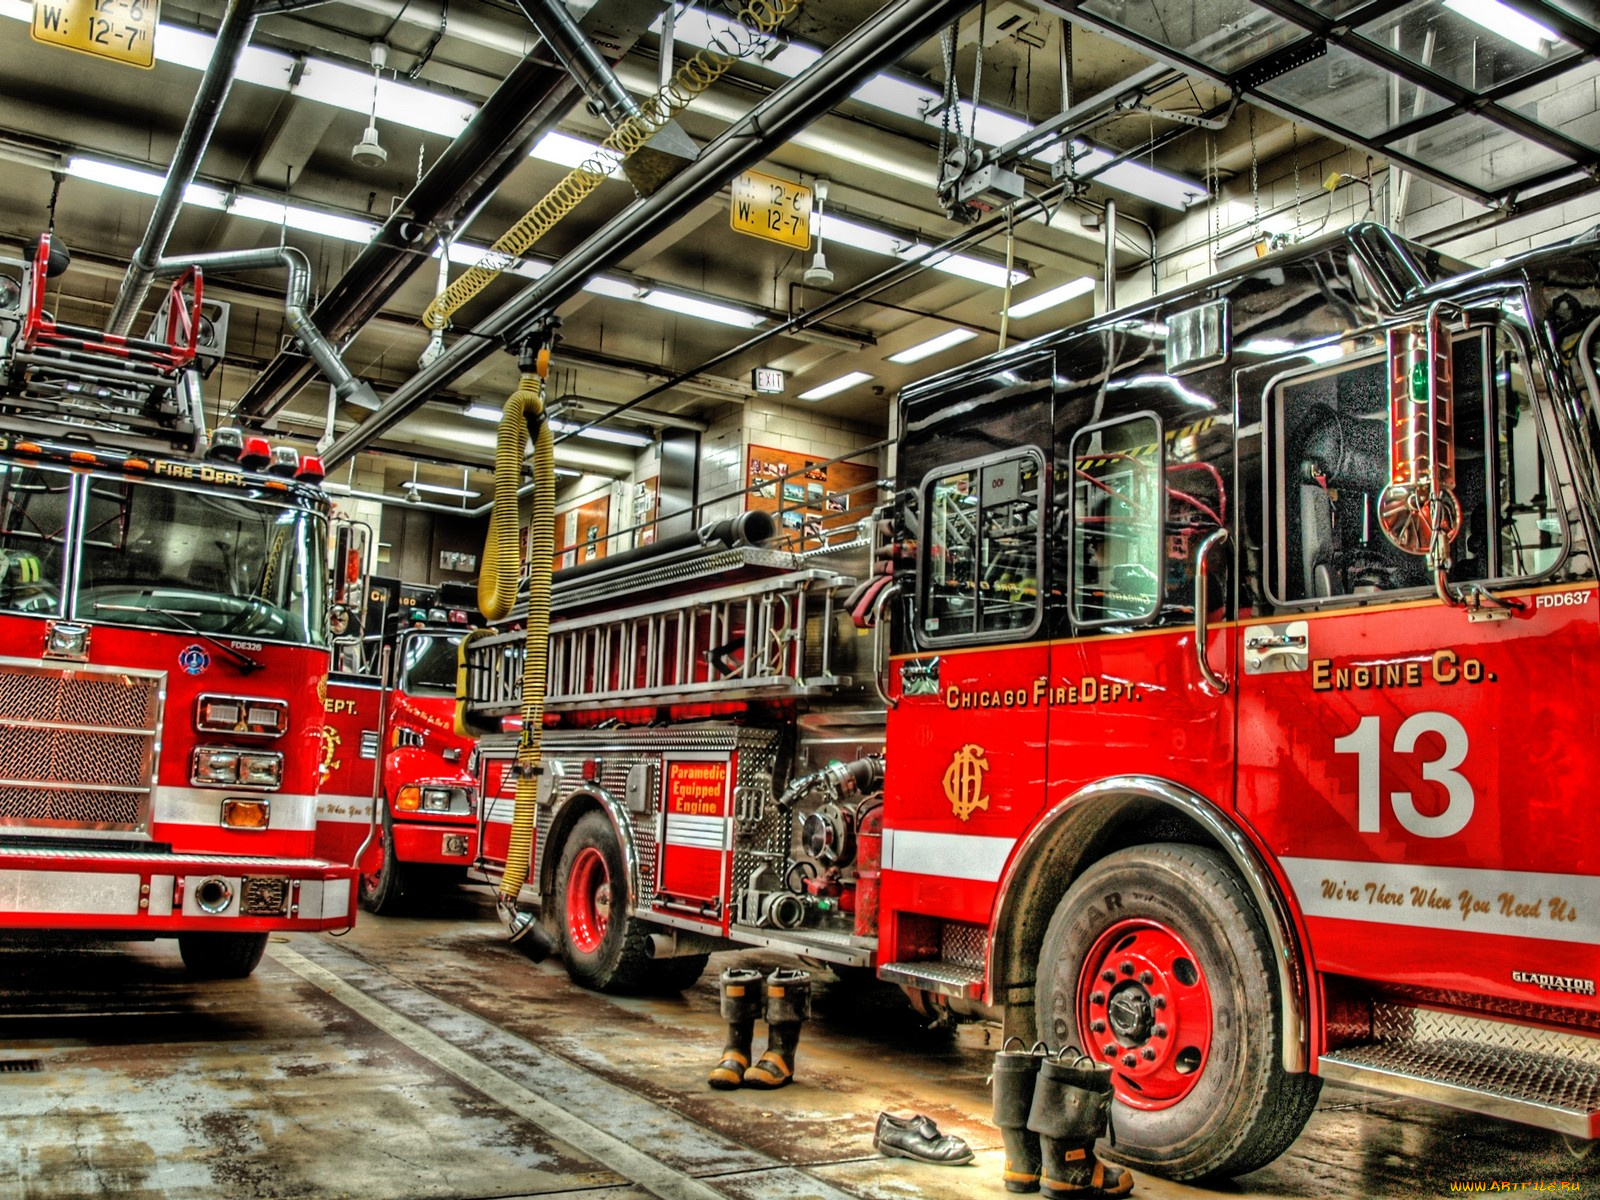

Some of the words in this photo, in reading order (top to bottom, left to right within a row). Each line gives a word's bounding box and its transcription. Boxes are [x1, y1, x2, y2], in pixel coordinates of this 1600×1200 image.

[44, 5, 68, 35] W:
[89, 17, 146, 51] 12'-7"
[769, 184, 805, 212] 12'-6"
[739, 201, 754, 224] W:
[767, 209, 804, 236] 12'-7"
[758, 371, 781, 388] EXIT
[154, 460, 193, 479] FIRE
[200, 468, 247, 487] DEPT.
[1535, 591, 1592, 608] FDD637
[1312, 658, 1421, 691] ENGINE
[1432, 649, 1498, 684] CO.
[946, 685, 1029, 709] CHICAGO
[1033, 679, 1077, 705] FIRE
[1081, 676, 1143, 704] DEPT.
[324, 698, 358, 715] EPT.
[671, 764, 726, 780] Paramedic
[1334, 711, 1475, 838] 13
[673, 780, 721, 798] Equipped
[676, 797, 717, 814] Engine
[1321, 879, 1359, 901] We're
[1365, 882, 1404, 906] There
[1410, 886, 1452, 910] When
[1458, 890, 1490, 921] You
[1497, 891, 1542, 918] Need
[1548, 896, 1577, 922] Us
[1512, 970, 1595, 992] GLADIATOR
